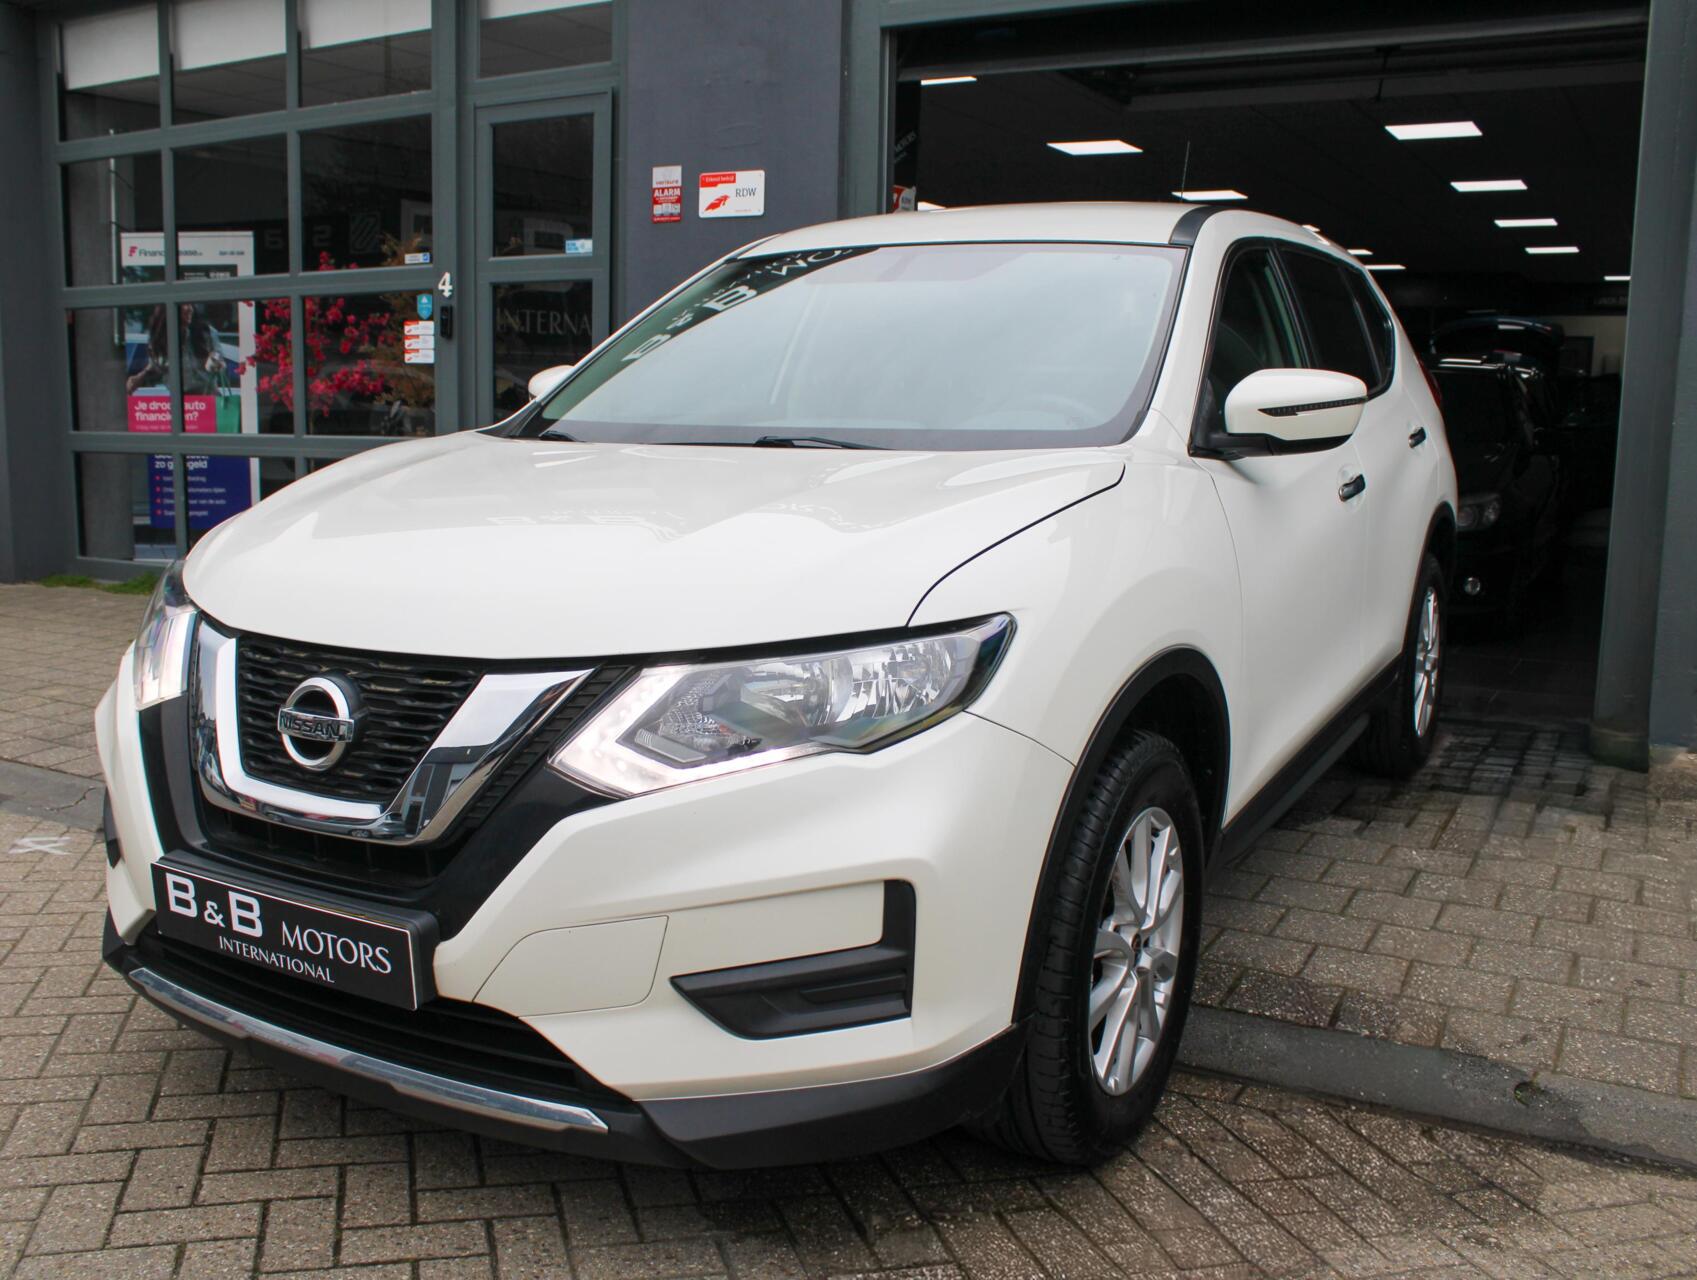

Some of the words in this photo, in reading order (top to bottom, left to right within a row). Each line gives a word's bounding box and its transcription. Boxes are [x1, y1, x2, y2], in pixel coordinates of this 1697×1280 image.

[653, 188, 681, 197] ALARM
[735, 187, 757, 197] RDW
[437, 271, 453, 298] 4
[134, 401, 147, 410] Je
[280, 710, 339, 739] NISSAN
[218, 935, 336, 983] INTERNATIONAL
[281, 920, 392, 974] MOTORS
